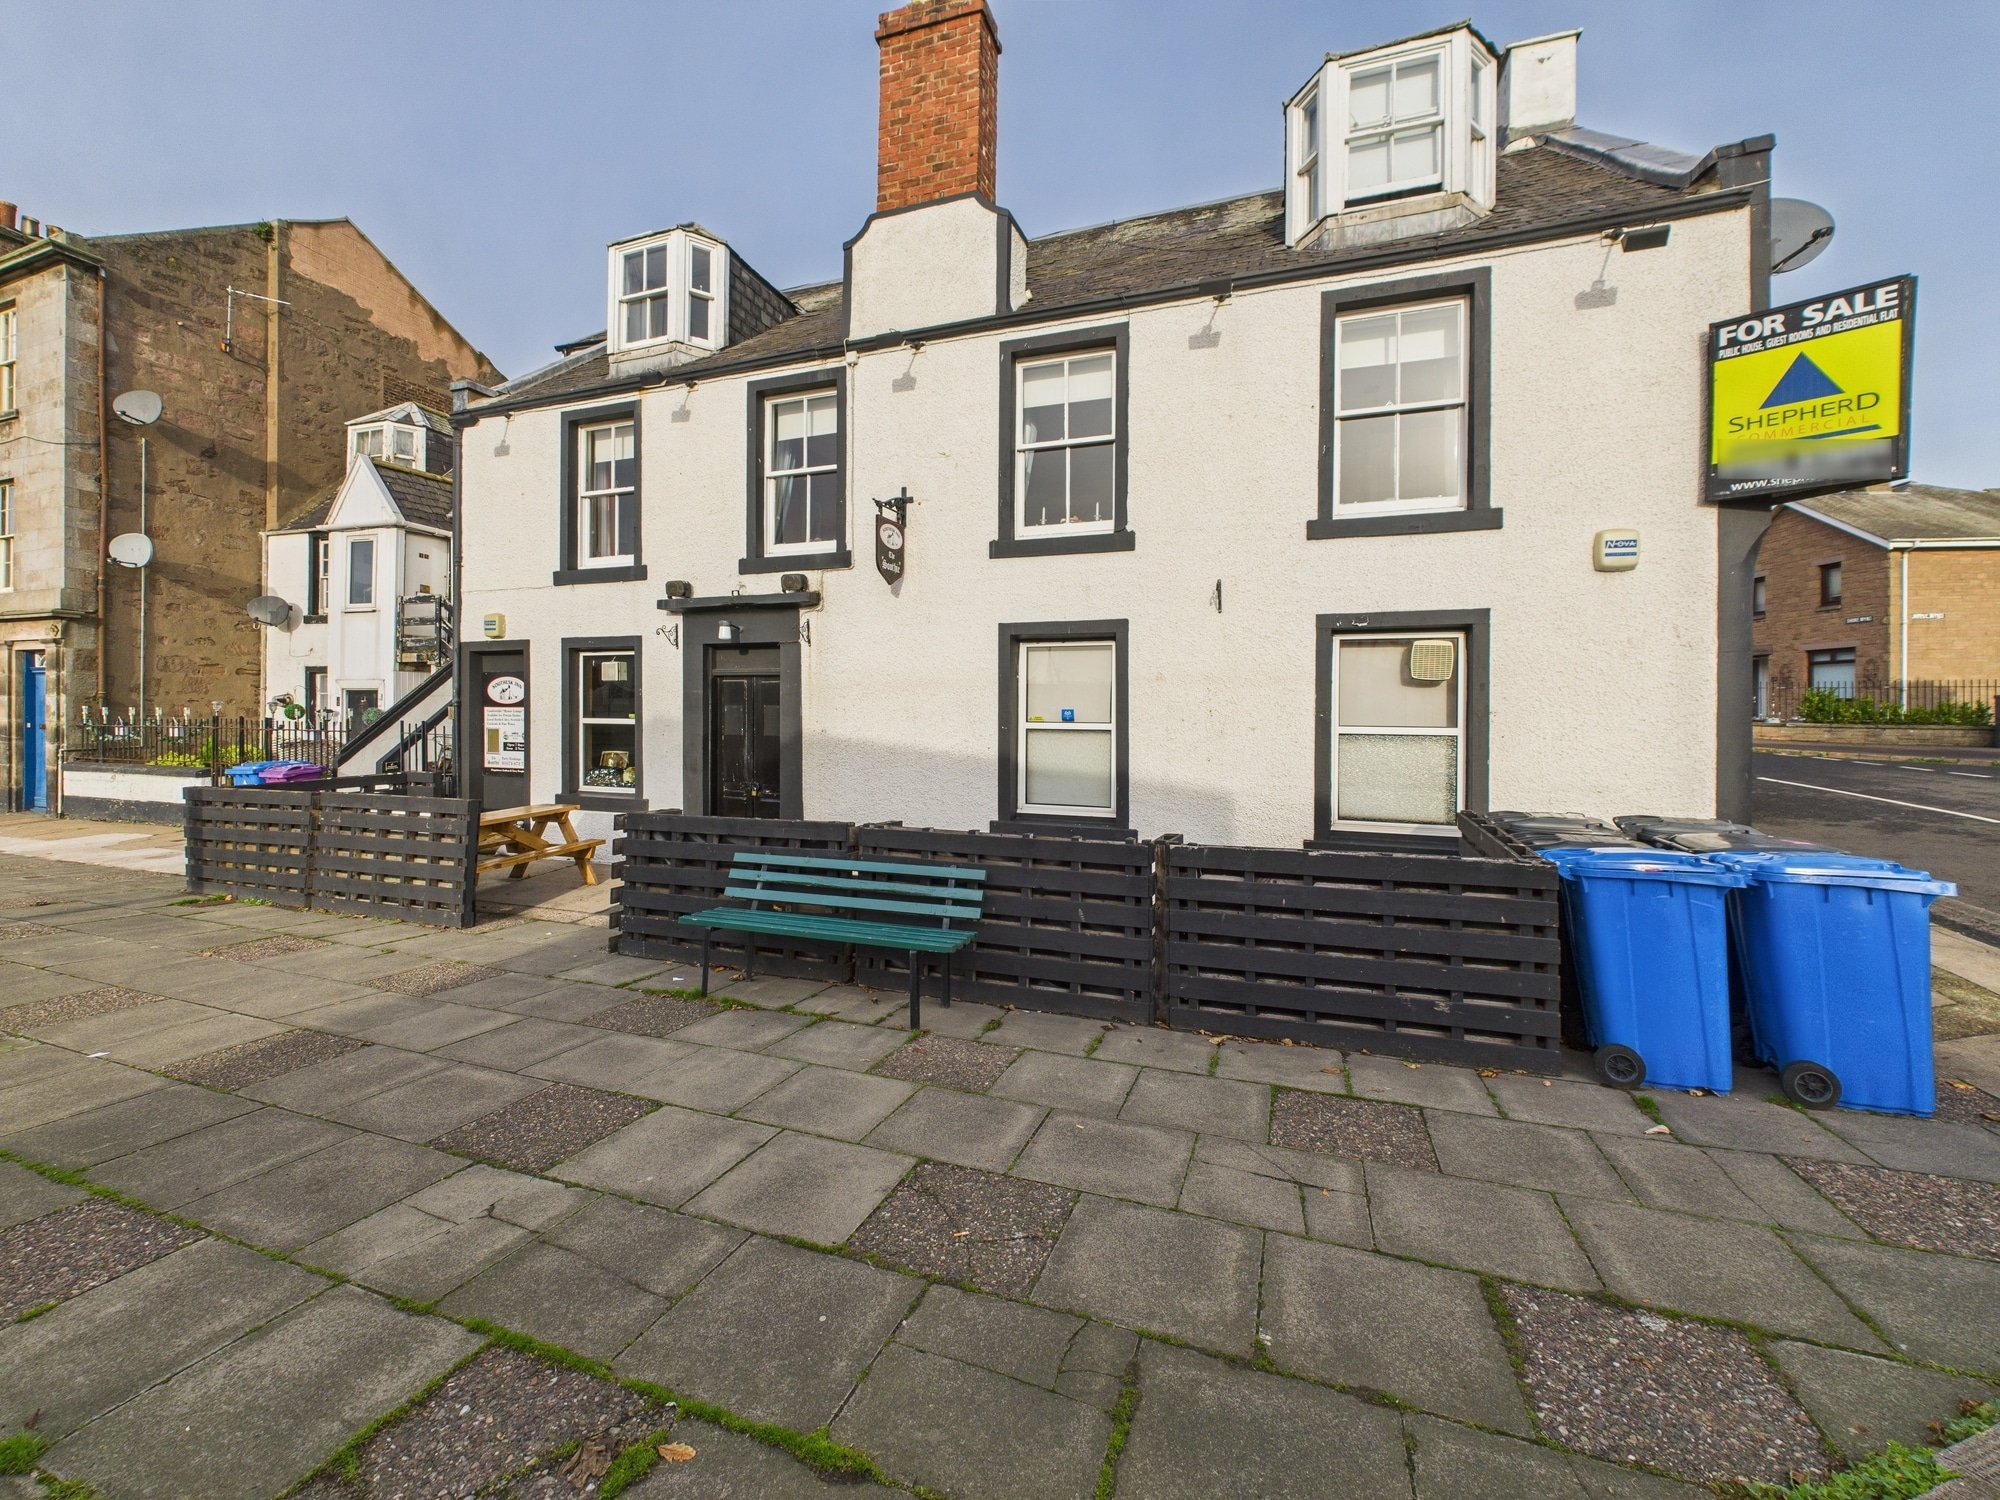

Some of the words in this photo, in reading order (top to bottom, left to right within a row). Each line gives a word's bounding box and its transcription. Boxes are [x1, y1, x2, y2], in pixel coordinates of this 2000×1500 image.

[1718, 314, 1786, 347] FOR
[1801, 283, 1899, 327] SALE
[1718, 345, 1741, 359] PUBLIC
[1741, 341, 1765, 356] HOUSE,
[1766, 334, 1787, 348] GUEST
[1788, 328, 1814, 343] ROOMS
[1815, 323, 1832, 336] AND
[1833, 313, 1879, 332] RESIDENTIAL
[1880, 307, 1899, 320] FLAT
[1728, 392, 1880, 434] SHEPHERD
[492, 679, 513, 689] SOUTHESK
